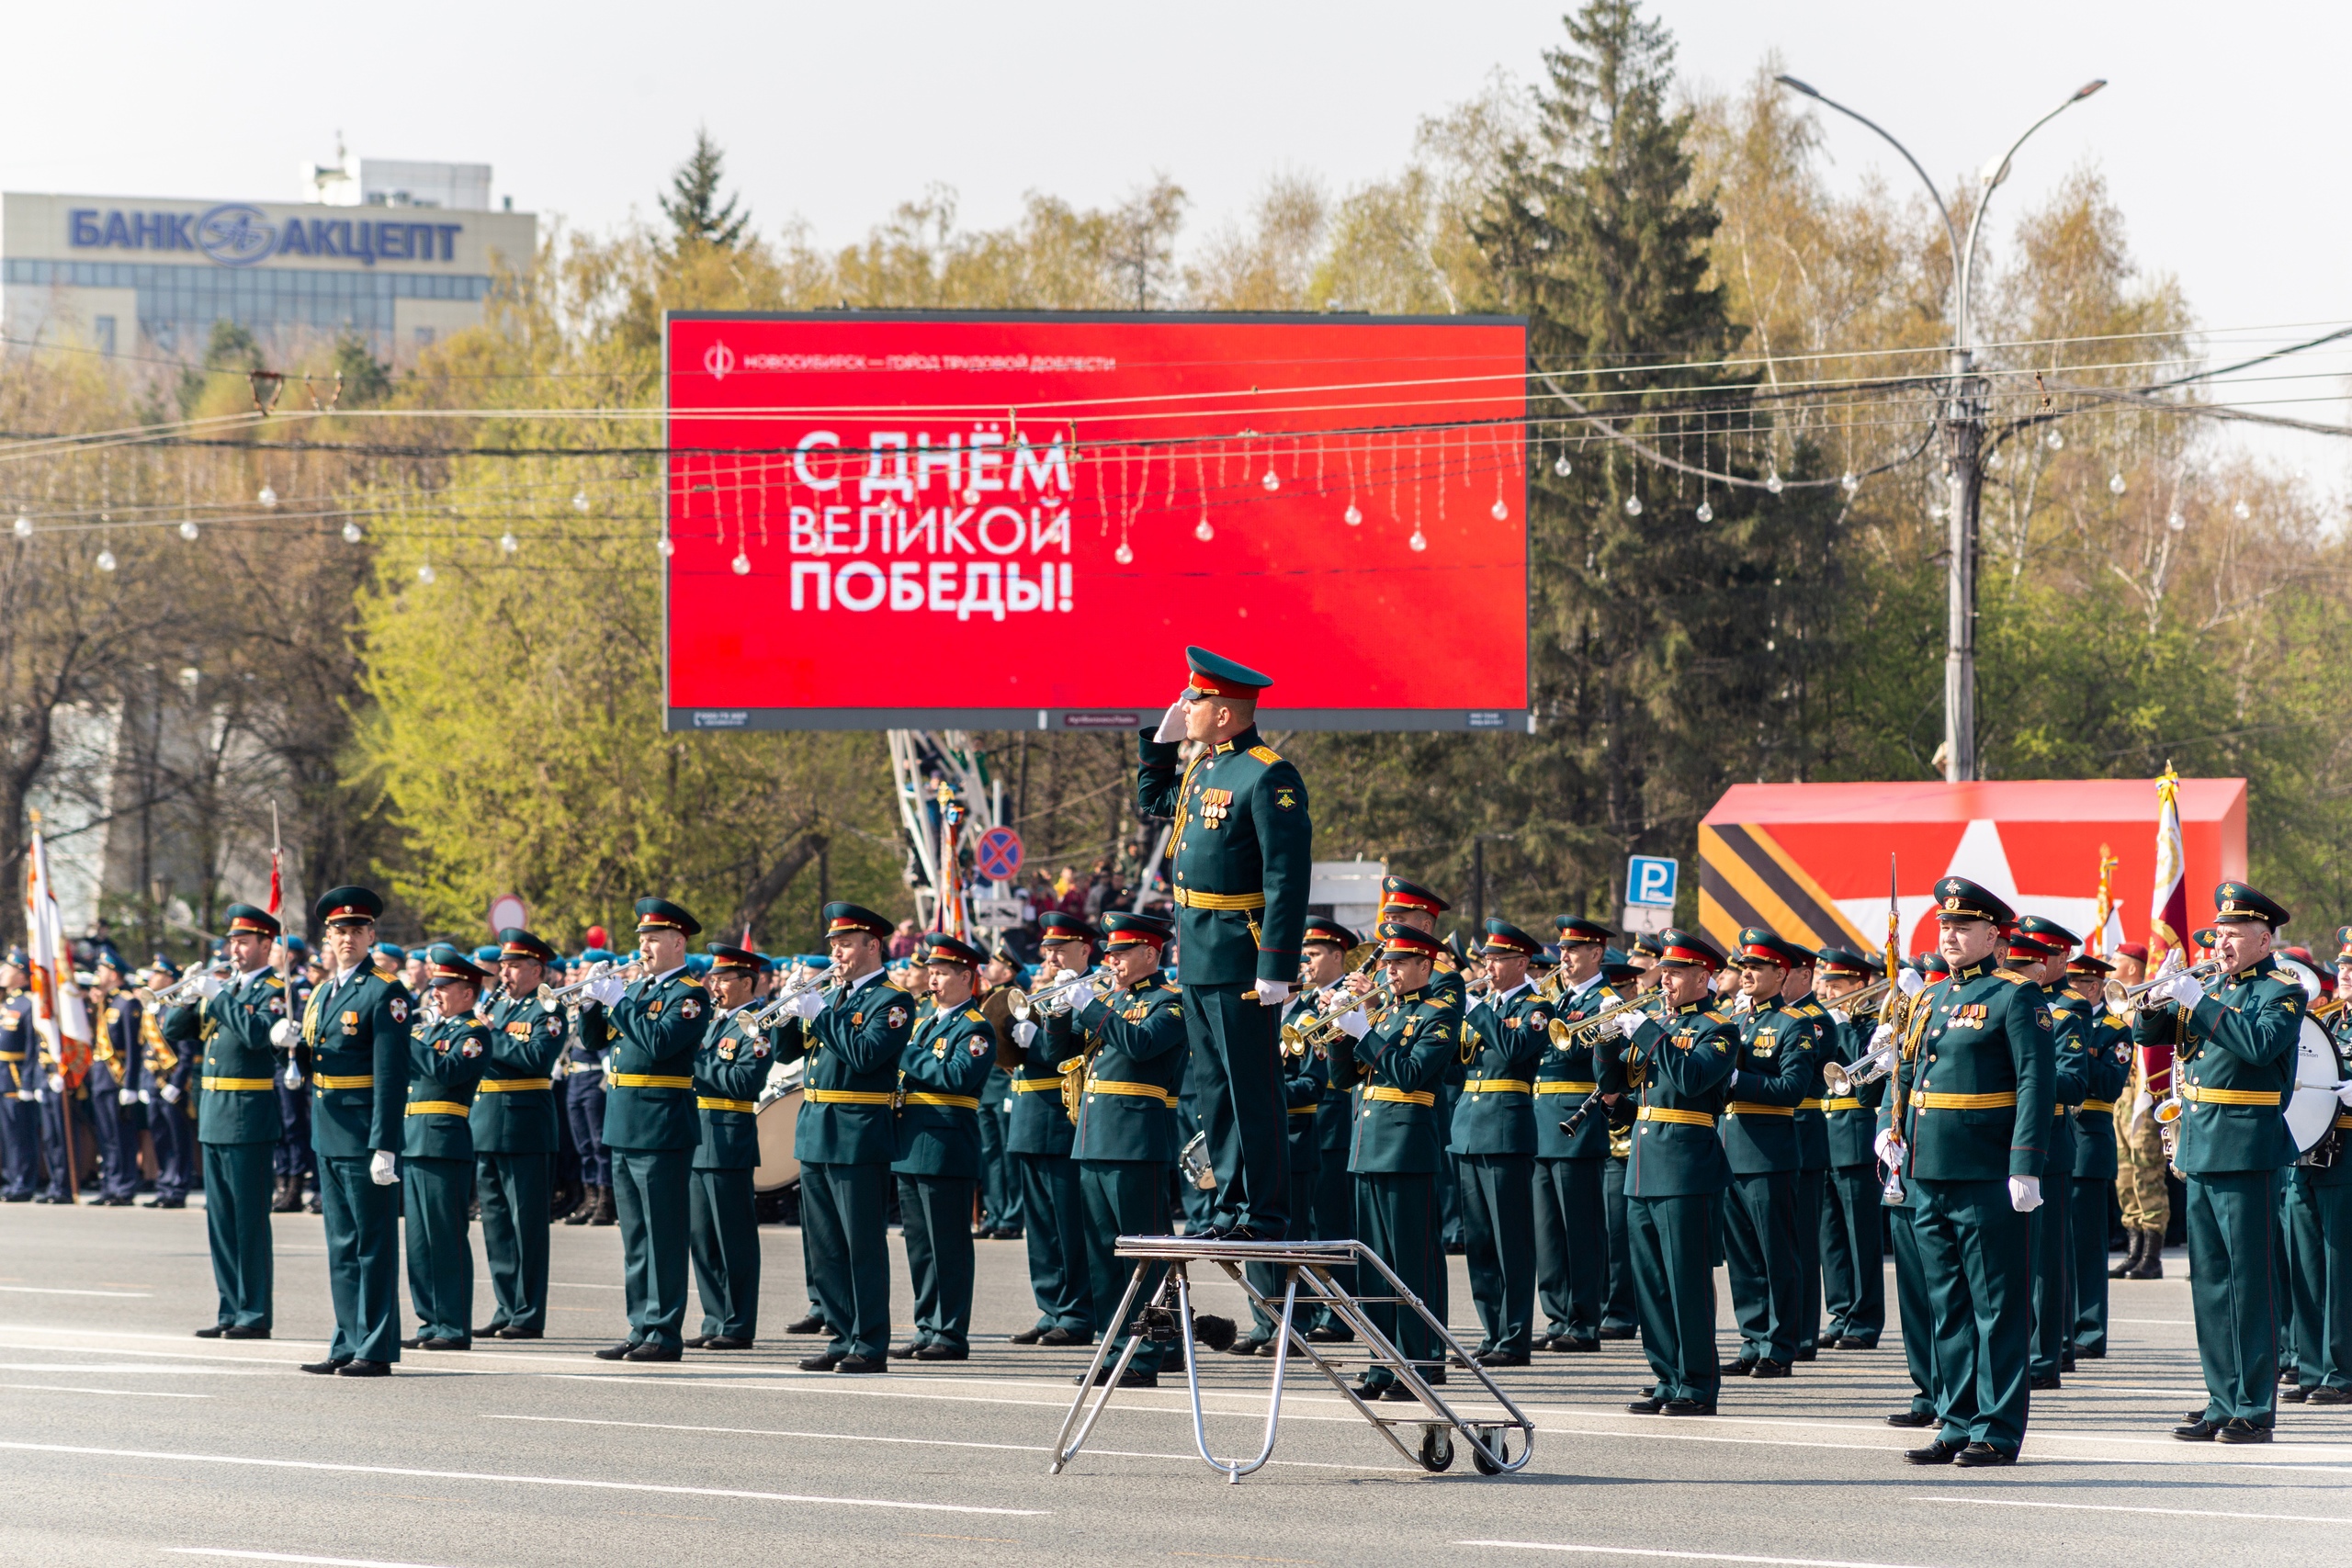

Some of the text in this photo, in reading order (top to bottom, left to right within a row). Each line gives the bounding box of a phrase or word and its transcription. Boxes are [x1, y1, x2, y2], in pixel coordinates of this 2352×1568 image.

[69, 208, 463, 265] БАНК АКЦЕПТ
[793, 423, 1071, 502] С ДНЁМ
[789, 497, 1071, 555] ВЕЛИКОЙ
[789, 561, 1074, 622] ПОБЕДЫ!
[1640, 863, 1668, 901] P
